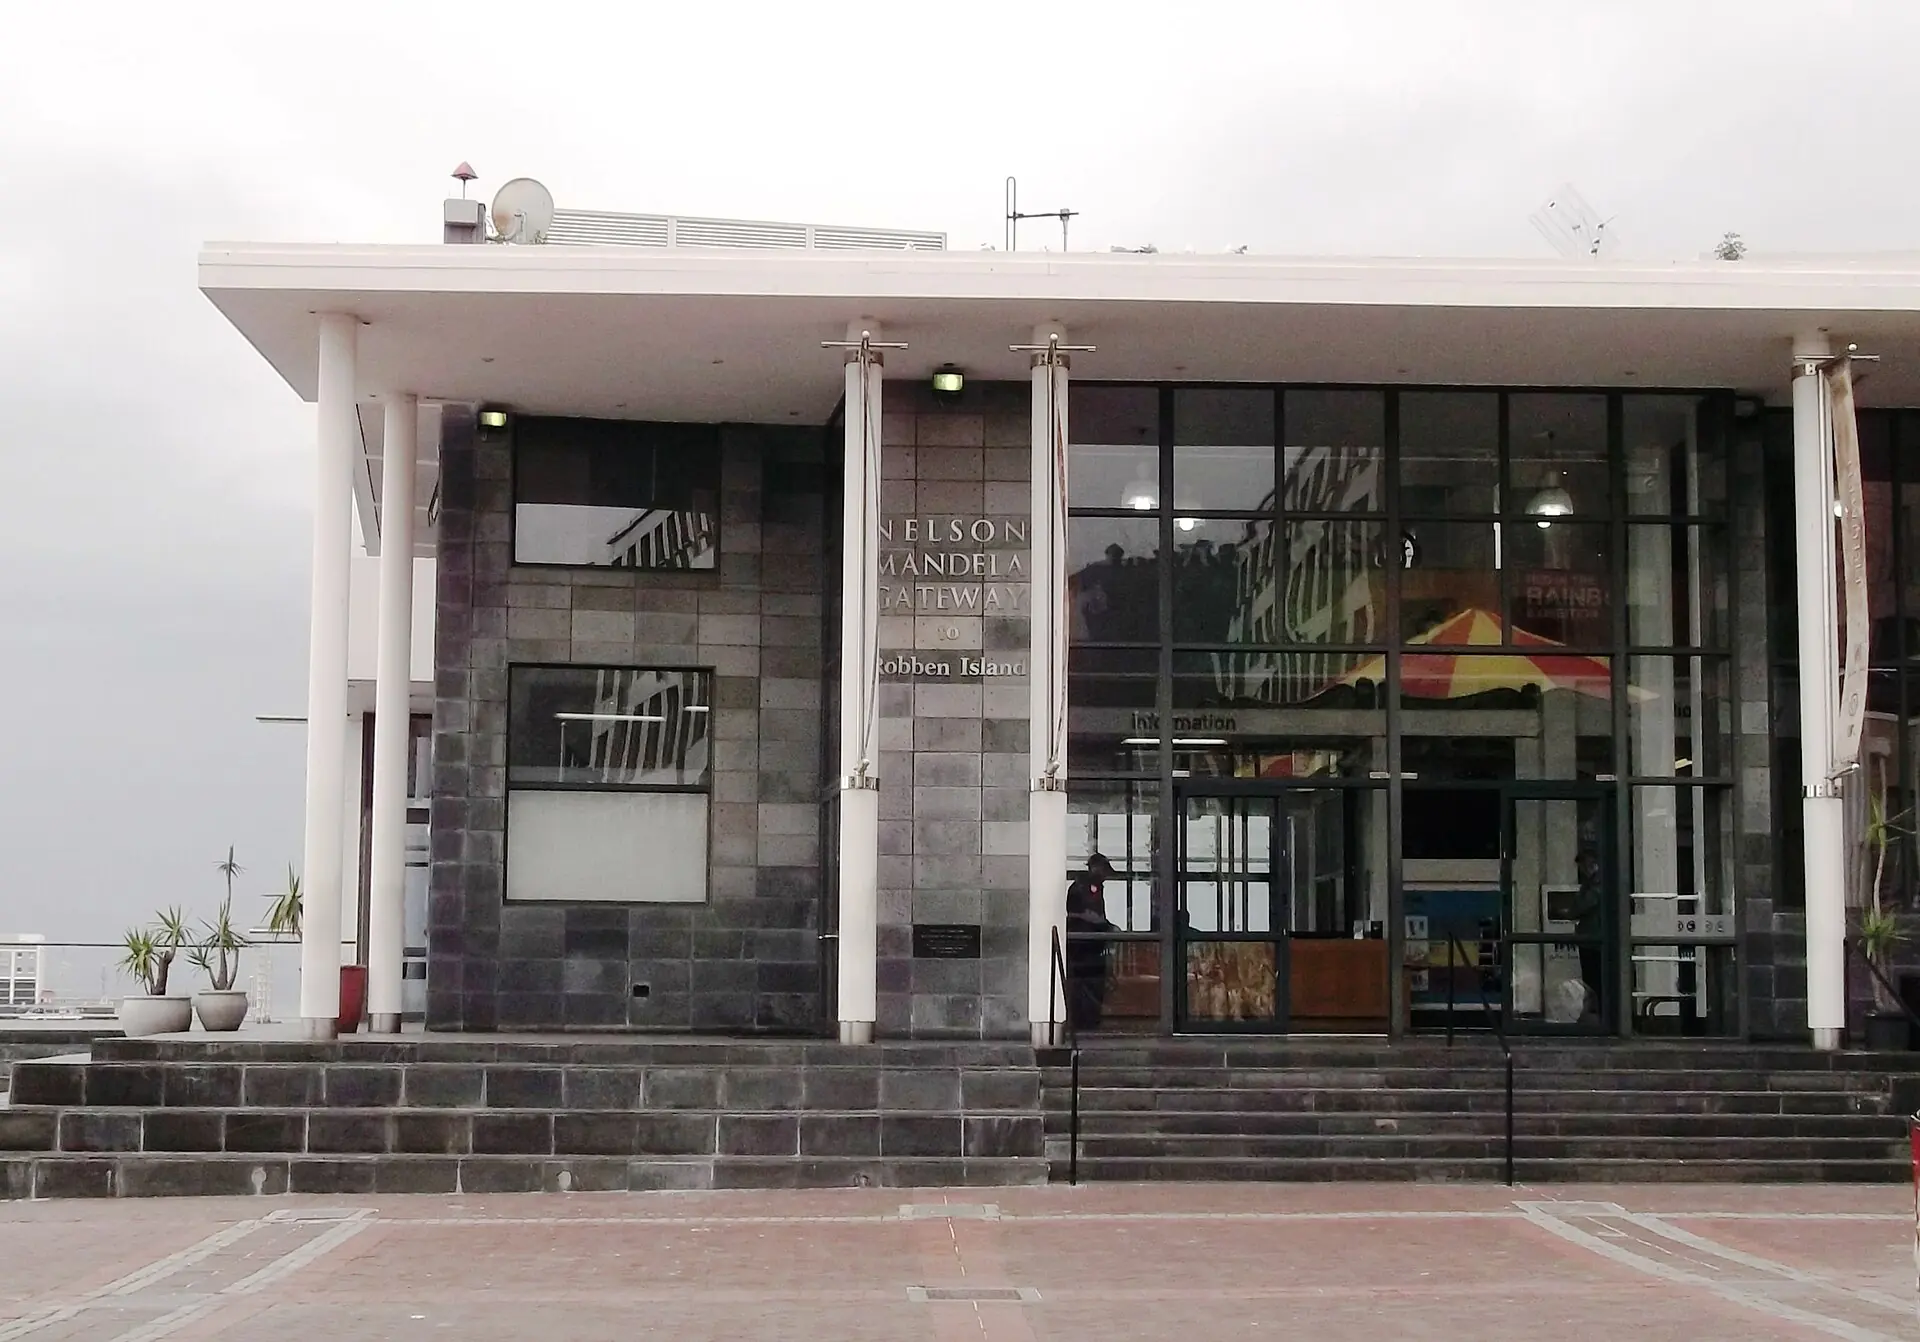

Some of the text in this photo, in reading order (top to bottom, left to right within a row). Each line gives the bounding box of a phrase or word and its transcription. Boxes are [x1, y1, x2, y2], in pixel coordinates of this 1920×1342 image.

[879, 519, 1026, 542] NELSON
[879, 553, 1023, 576] MANDELA
[960, 656, 1027, 676] Island
[1131, 712, 1237, 731] infomation
